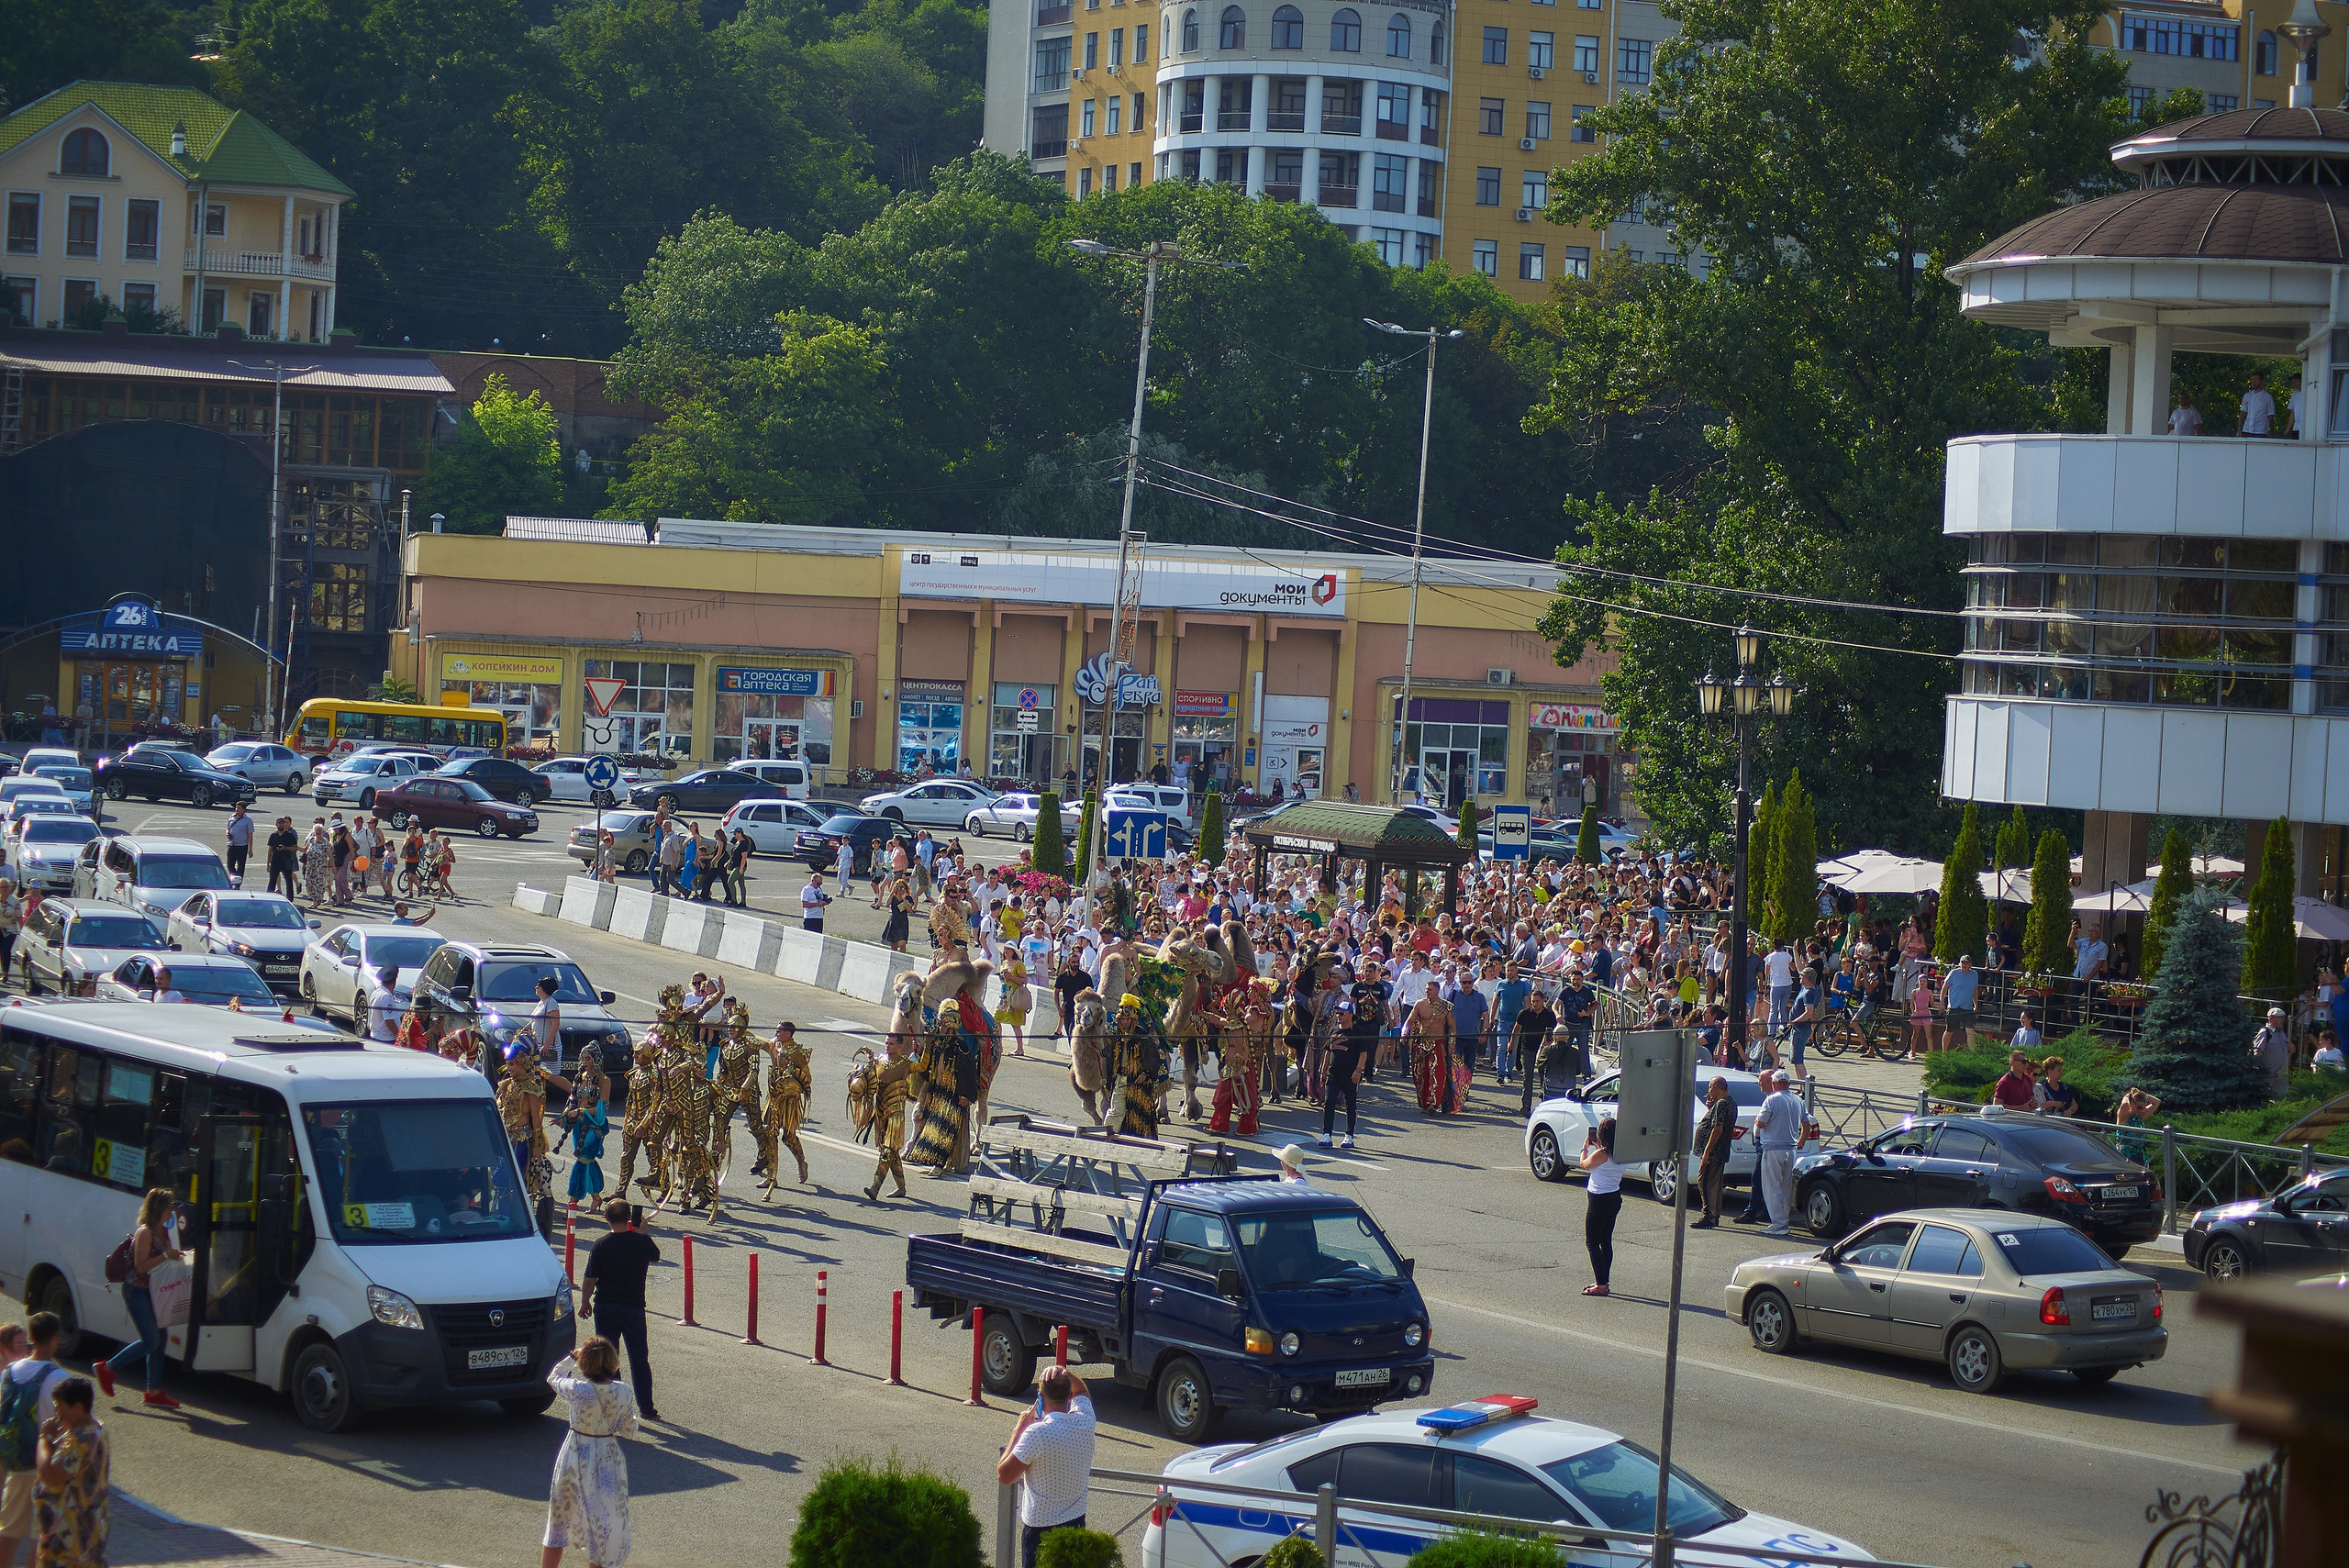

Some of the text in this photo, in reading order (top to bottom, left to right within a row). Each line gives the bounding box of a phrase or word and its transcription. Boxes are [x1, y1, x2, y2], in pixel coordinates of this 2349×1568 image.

[1275, 584, 1306, 595] мои
[1219, 592, 1306, 606] документы
[116, 606, 142, 625] 26
[83, 632, 180, 651] АПТЕКА
[472, 662, 555, 673] КОПЕЙКИН ДОМ
[903, 682, 963, 691] ЦЕНТРОКАССА
[1177, 695, 1223, 704] СПОРТИВНО
[336, 728, 344, 737] 4
[1273, 835, 1335, 852] ОКТЯБРЬСКАЯ ПЛОЩАДЬ
[95, 1141, 109, 1175] 3
[350, 1207, 364, 1227] 3
[510, 1347, 526, 1358] 126
[1338, 1369, 1386, 1384] М471АН 26
